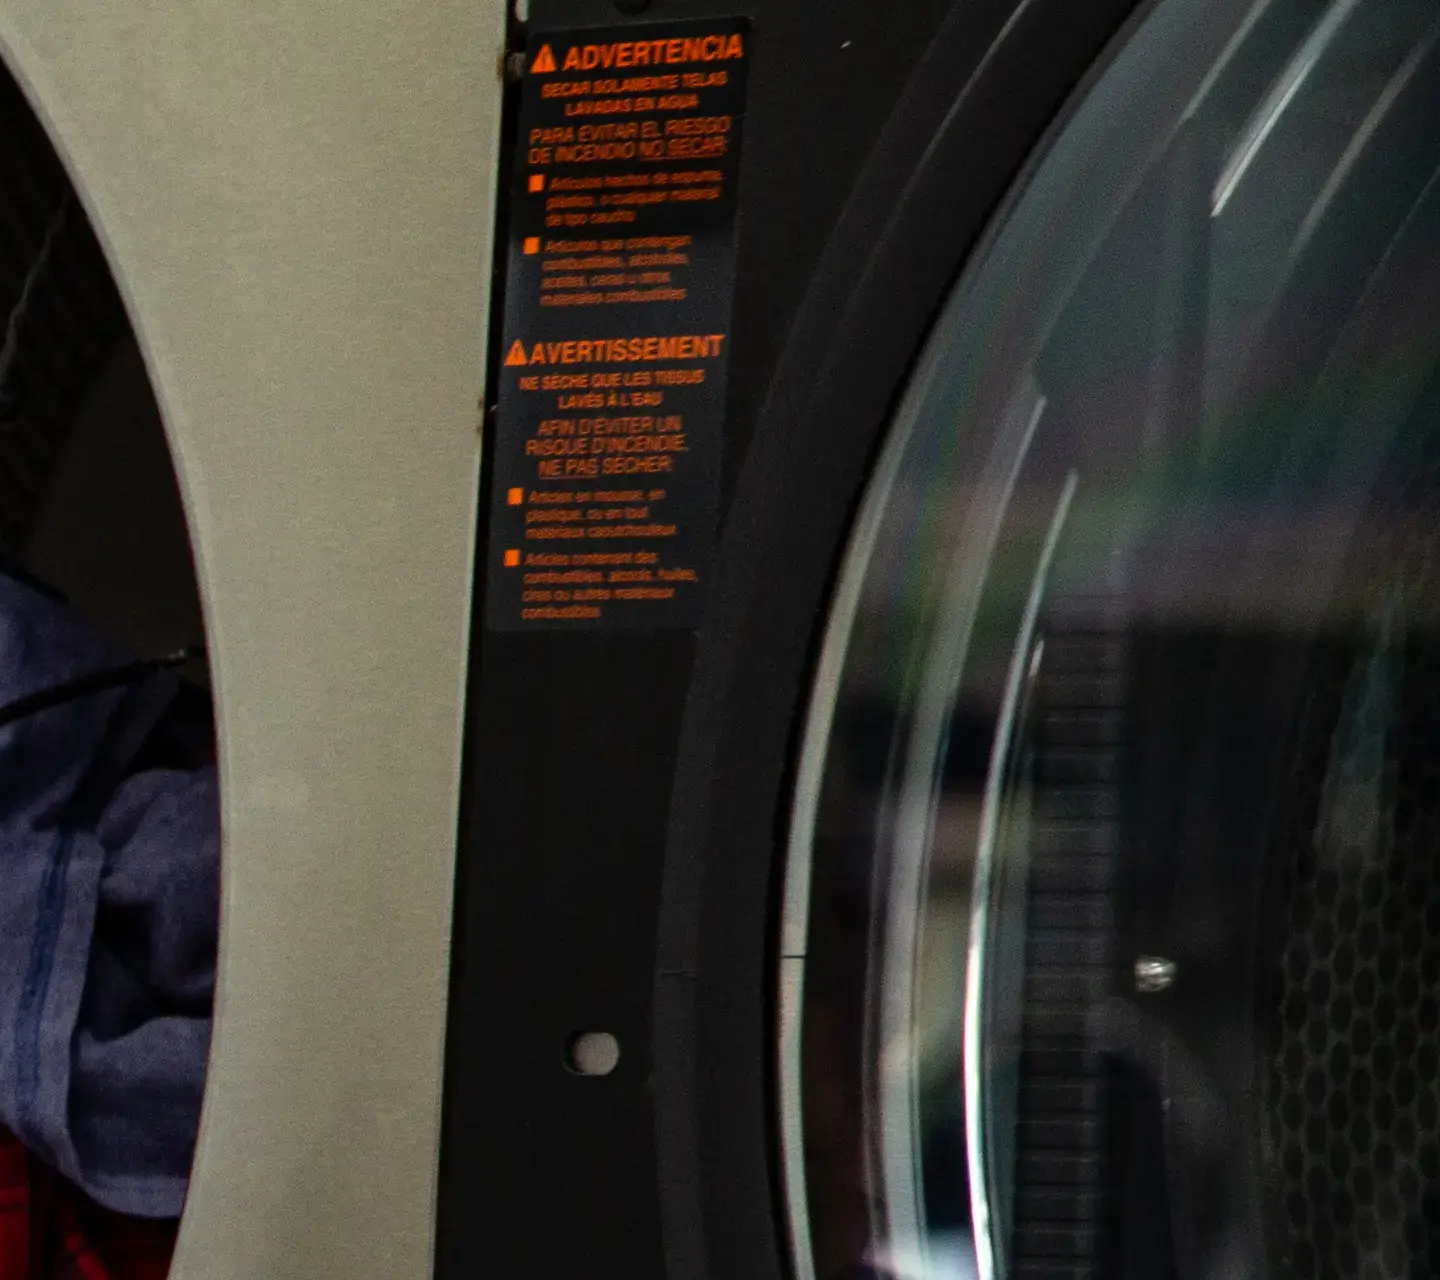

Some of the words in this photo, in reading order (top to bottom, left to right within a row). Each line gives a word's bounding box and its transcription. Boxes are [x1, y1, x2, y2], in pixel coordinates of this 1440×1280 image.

[562, 33, 743, 71] ADVERTENCIA
[541, 81, 590, 98] SECAR
[593, 74, 679, 95] SOLAMENTE
[682, 70, 728, 88] TELAS
[565, 98, 631, 116] LAVADAS
[529, 126, 574, 145] PARA
[578, 121, 638, 142] EVITAR
[641, 121, 661, 139] EL
[665, 116, 733, 136] RIESGO
[528, 146, 552, 165] DE
[554, 141, 635, 164] INCENDIO
[529, 333, 725, 365] AVERTISSEMENT
[519, 374, 539, 391] NE
[592, 371, 623, 388] QUE
[654, 368, 706, 385] TISSUS
[536, 417, 575, 436] AFIN
[656, 414, 683, 432] UN
[525, 437, 592, 456] RISQUE
[538, 458, 562, 477] NE
[565, 456, 599, 476] PAS
